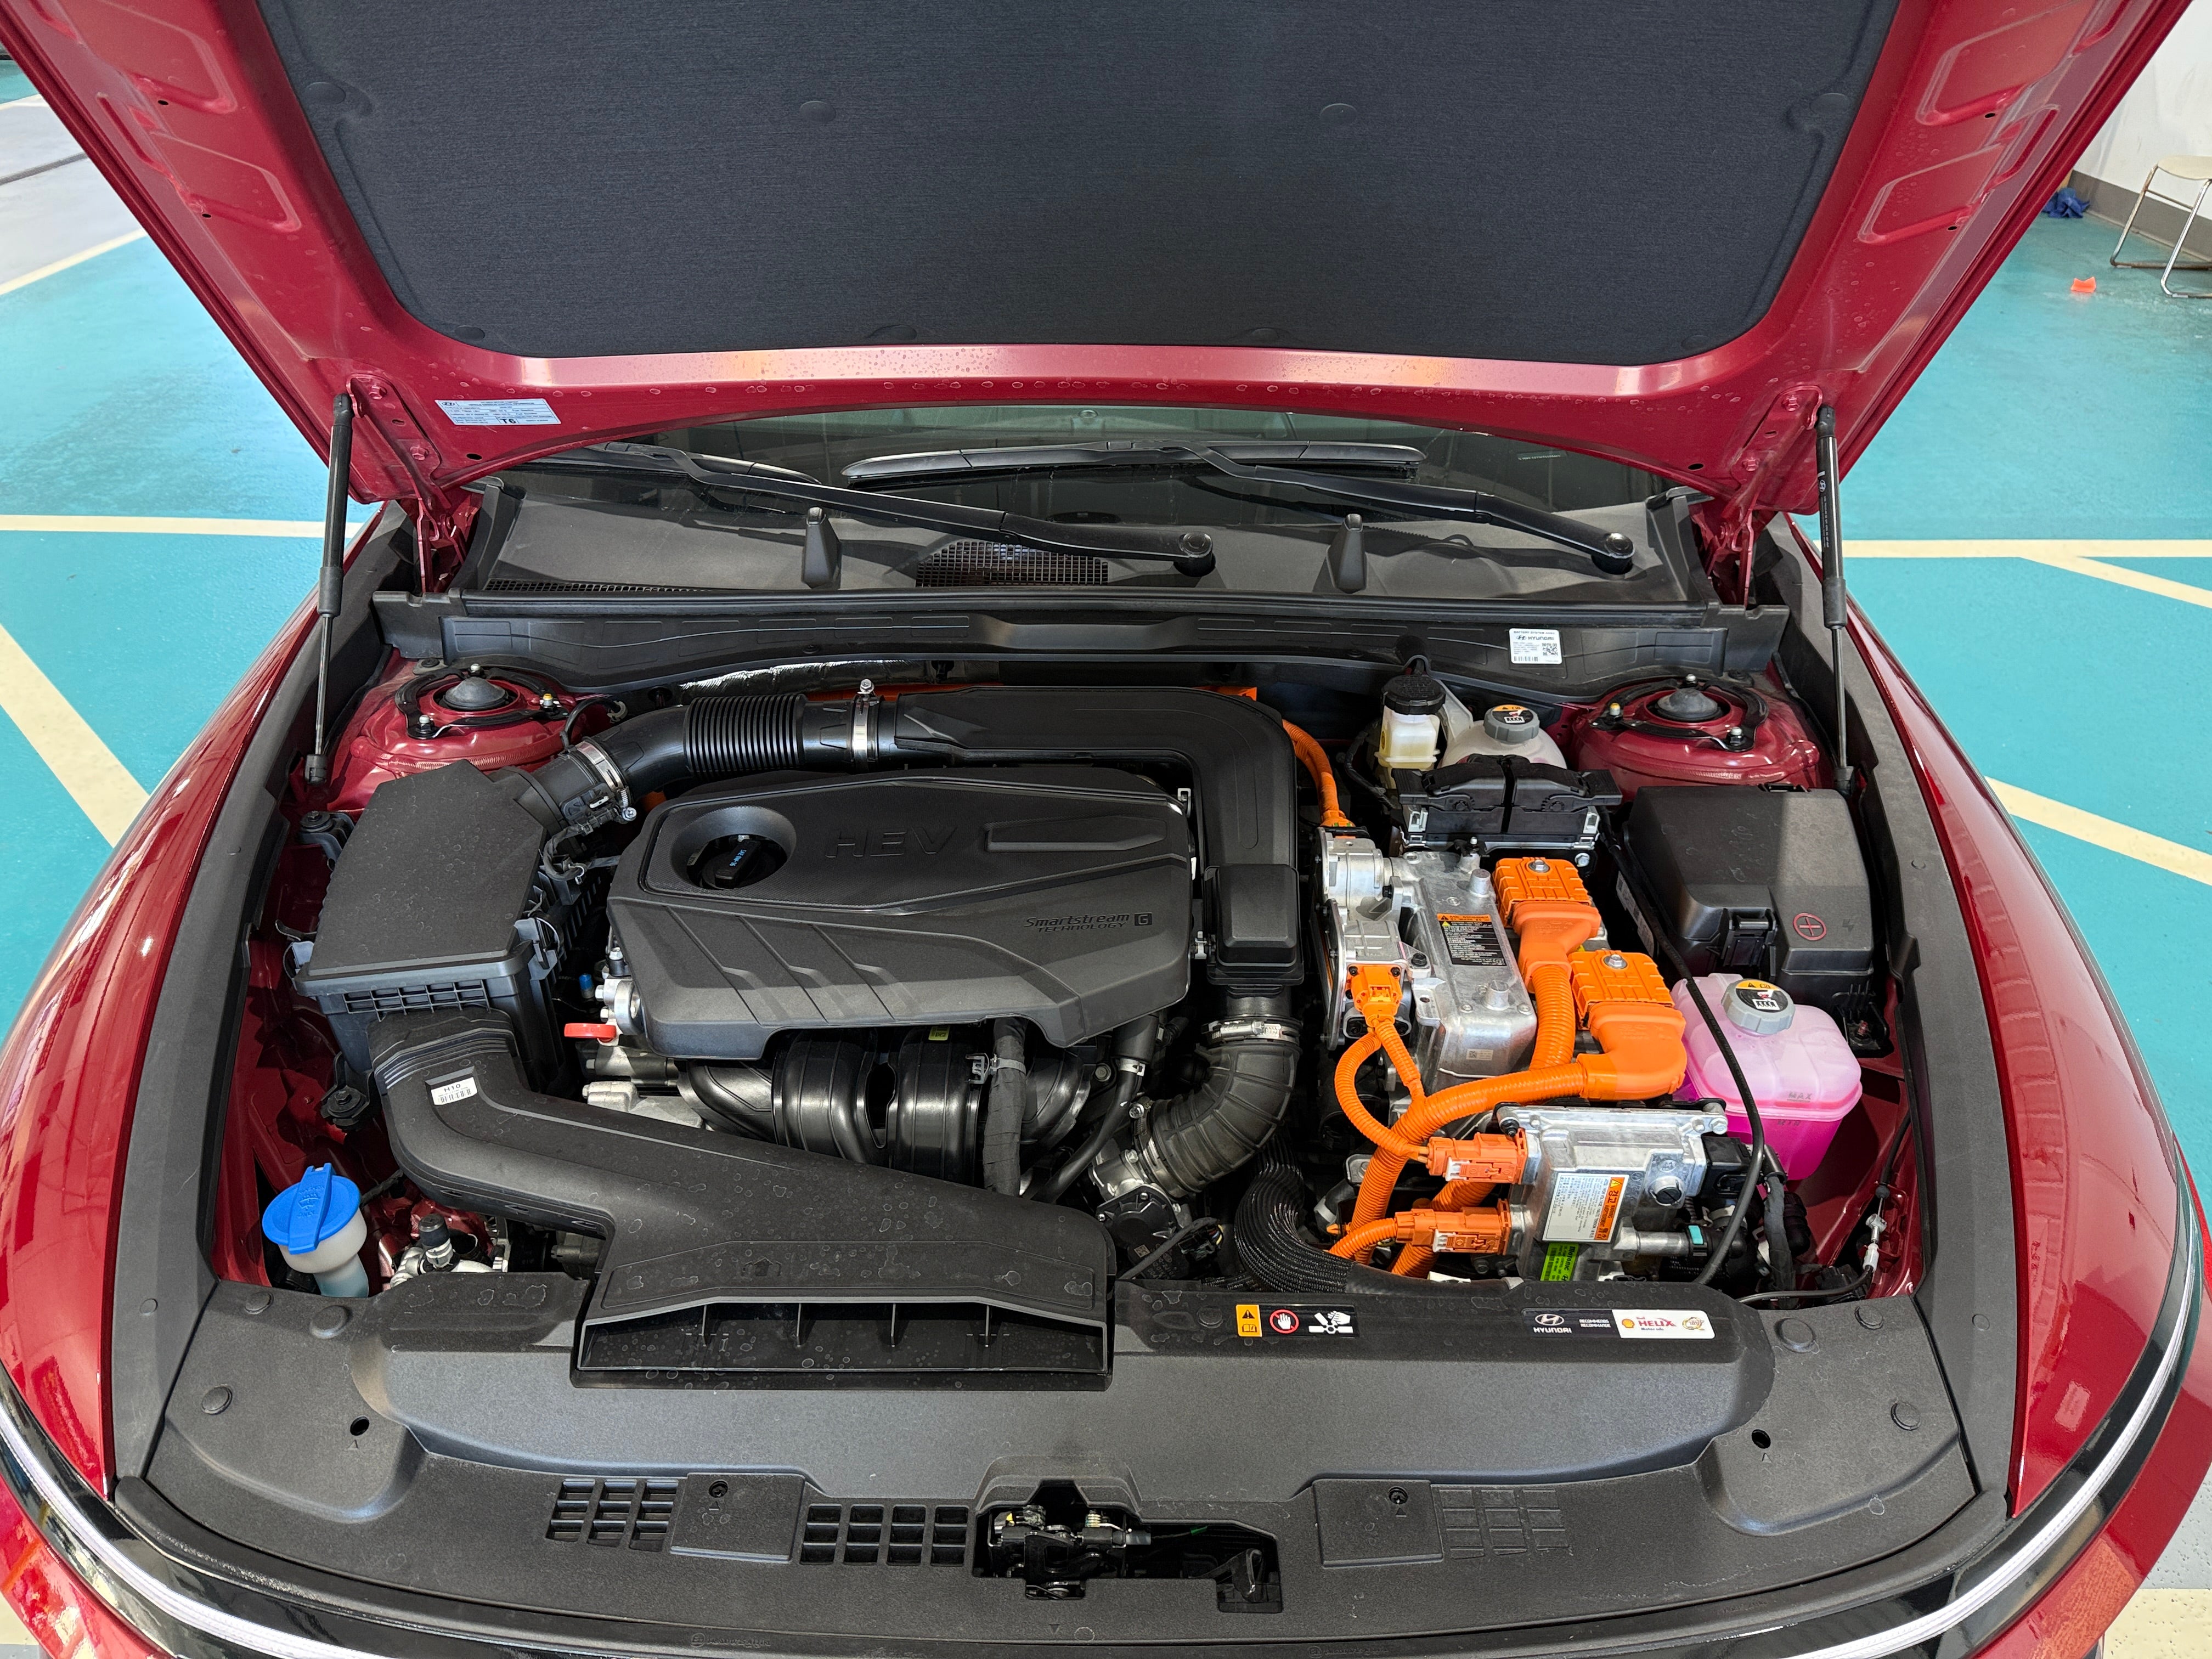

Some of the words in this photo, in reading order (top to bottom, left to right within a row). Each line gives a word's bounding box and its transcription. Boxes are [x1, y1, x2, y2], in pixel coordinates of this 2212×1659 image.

[825, 826, 957, 858] HEV
[1024, 913, 1130, 927] Smartstream
[1136, 913, 1150, 926] G
[1037, 922, 1126, 933] TECHNOLOGY
[444, 1084, 461, 1092] H10
[1607, 1190, 1618, 1204] 경고
